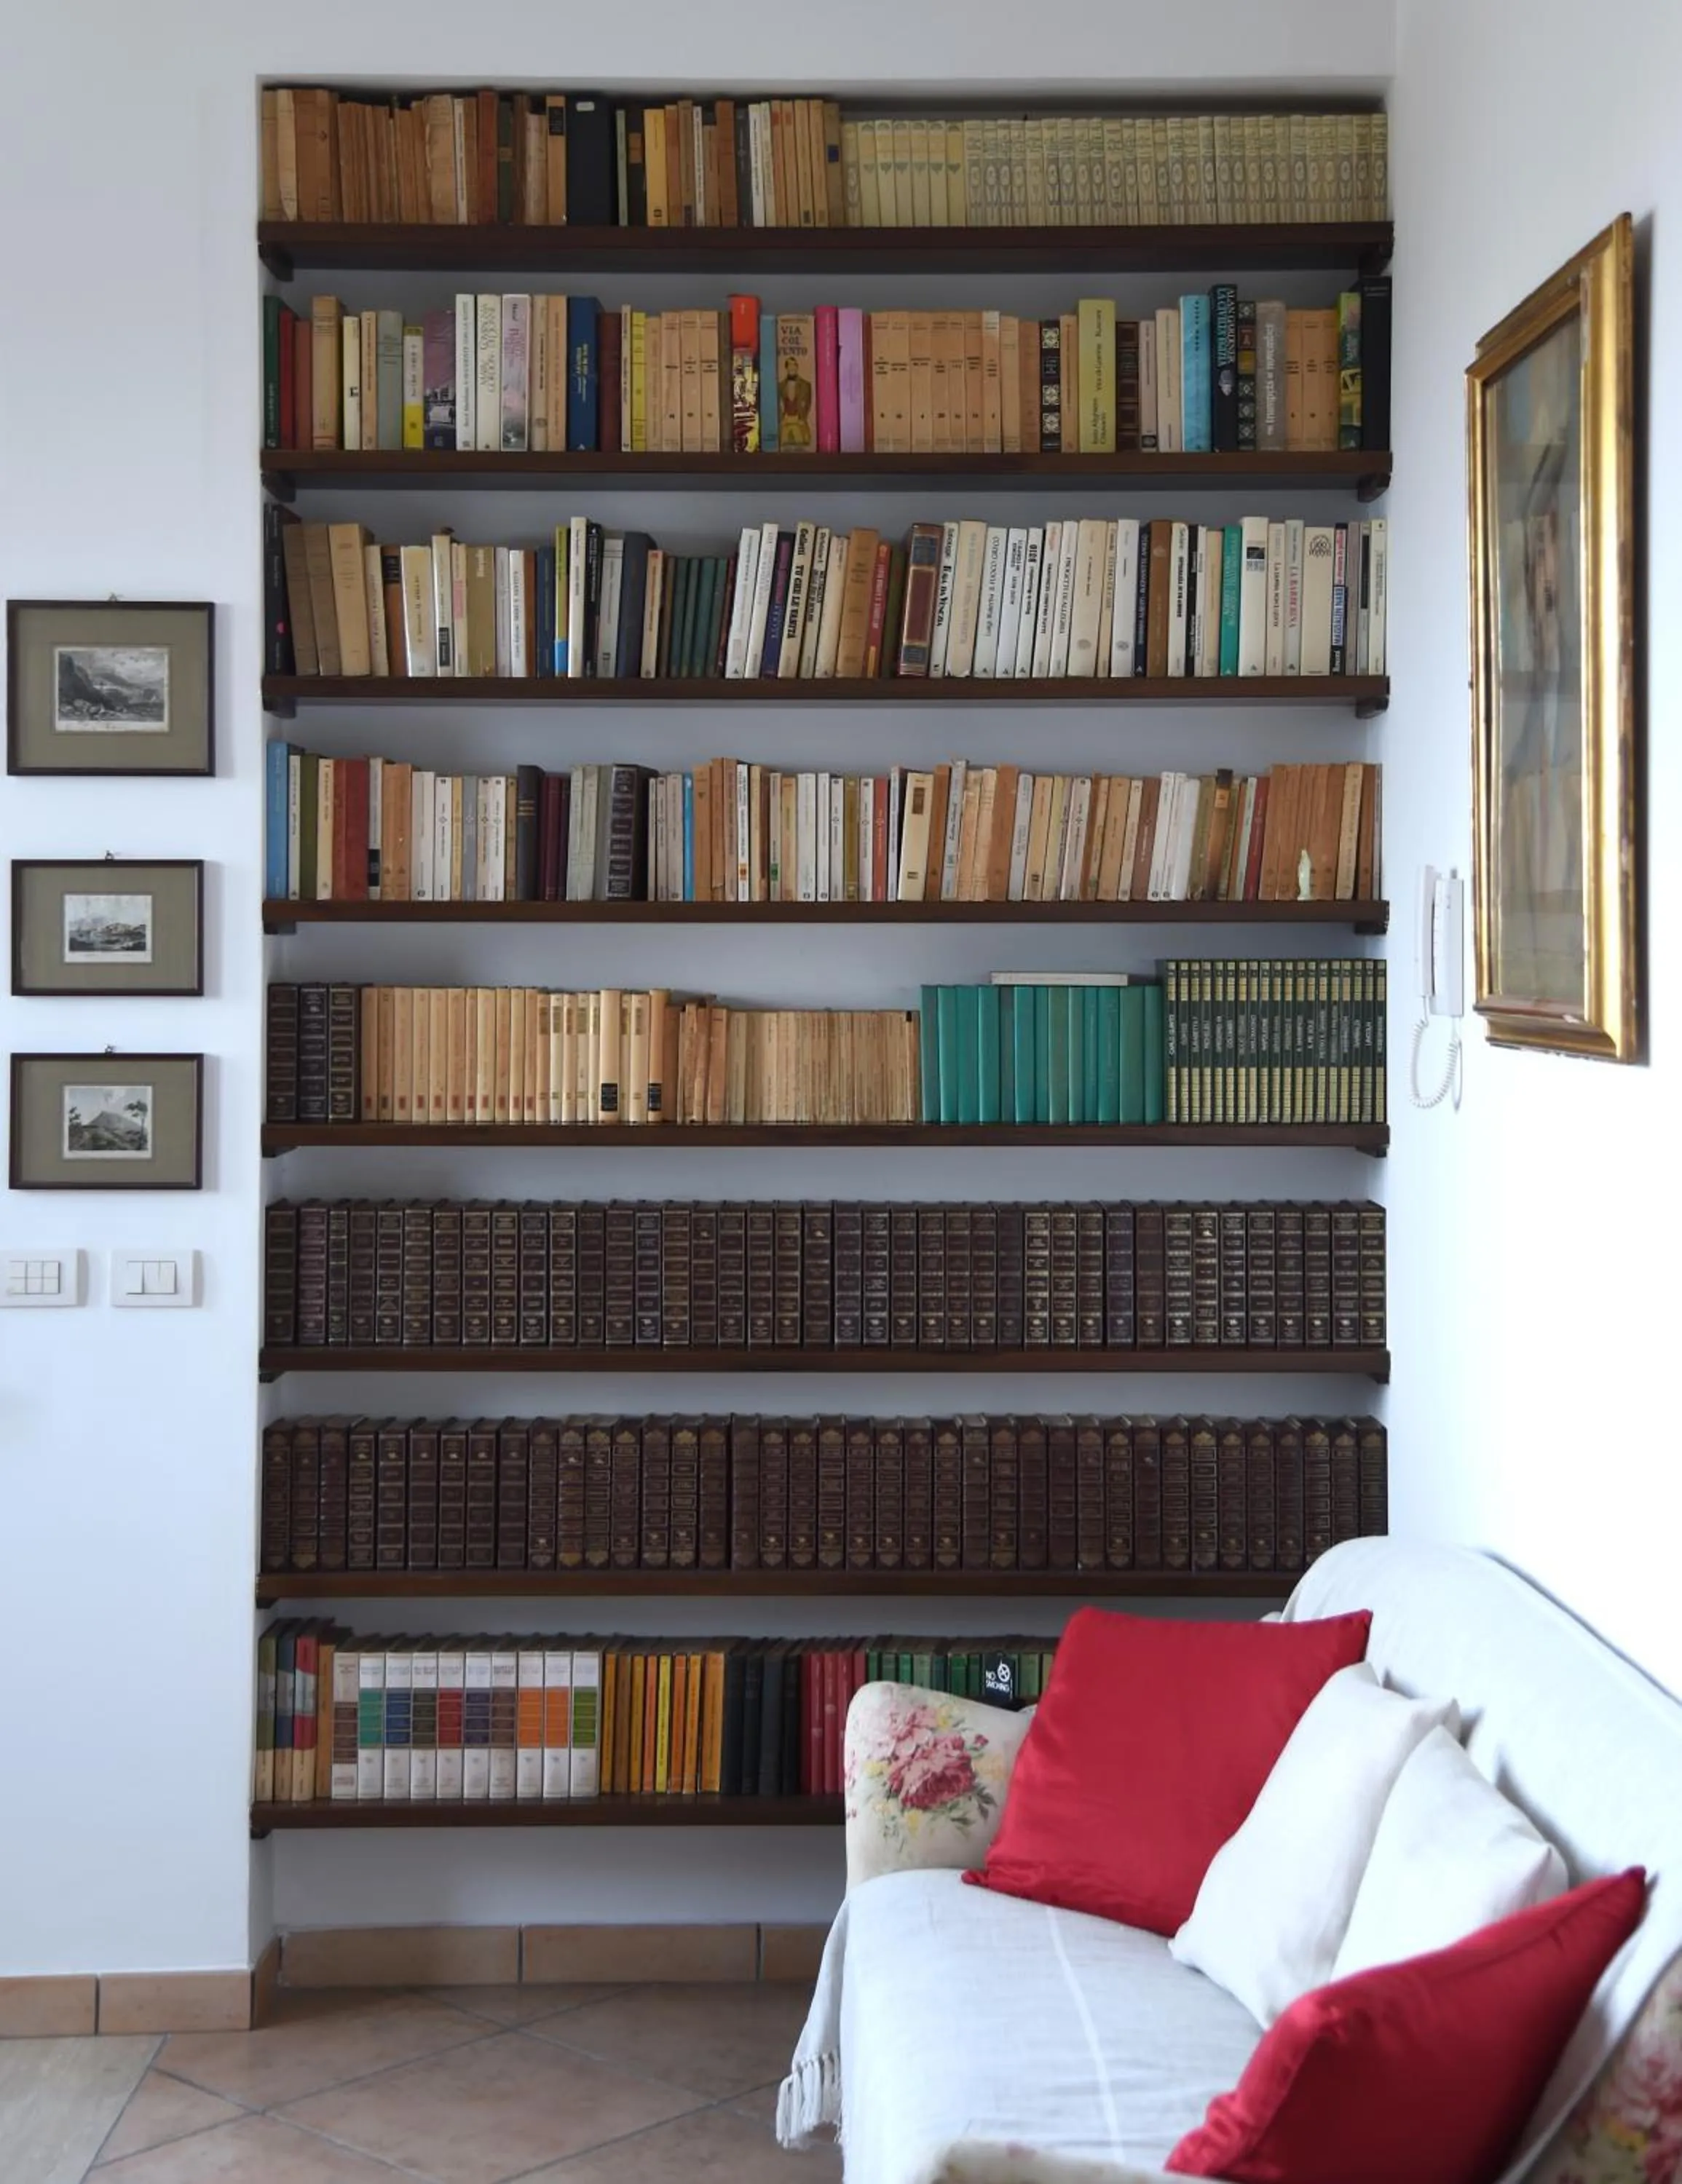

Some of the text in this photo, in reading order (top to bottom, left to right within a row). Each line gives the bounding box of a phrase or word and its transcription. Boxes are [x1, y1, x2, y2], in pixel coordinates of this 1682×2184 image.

[781, 326, 802, 335] VIA
[781, 336, 800, 345] COL
[794, 564, 804, 575] TU
[792, 577, 802, 594] CHE
[985, 1670, 996, 1680] NO
